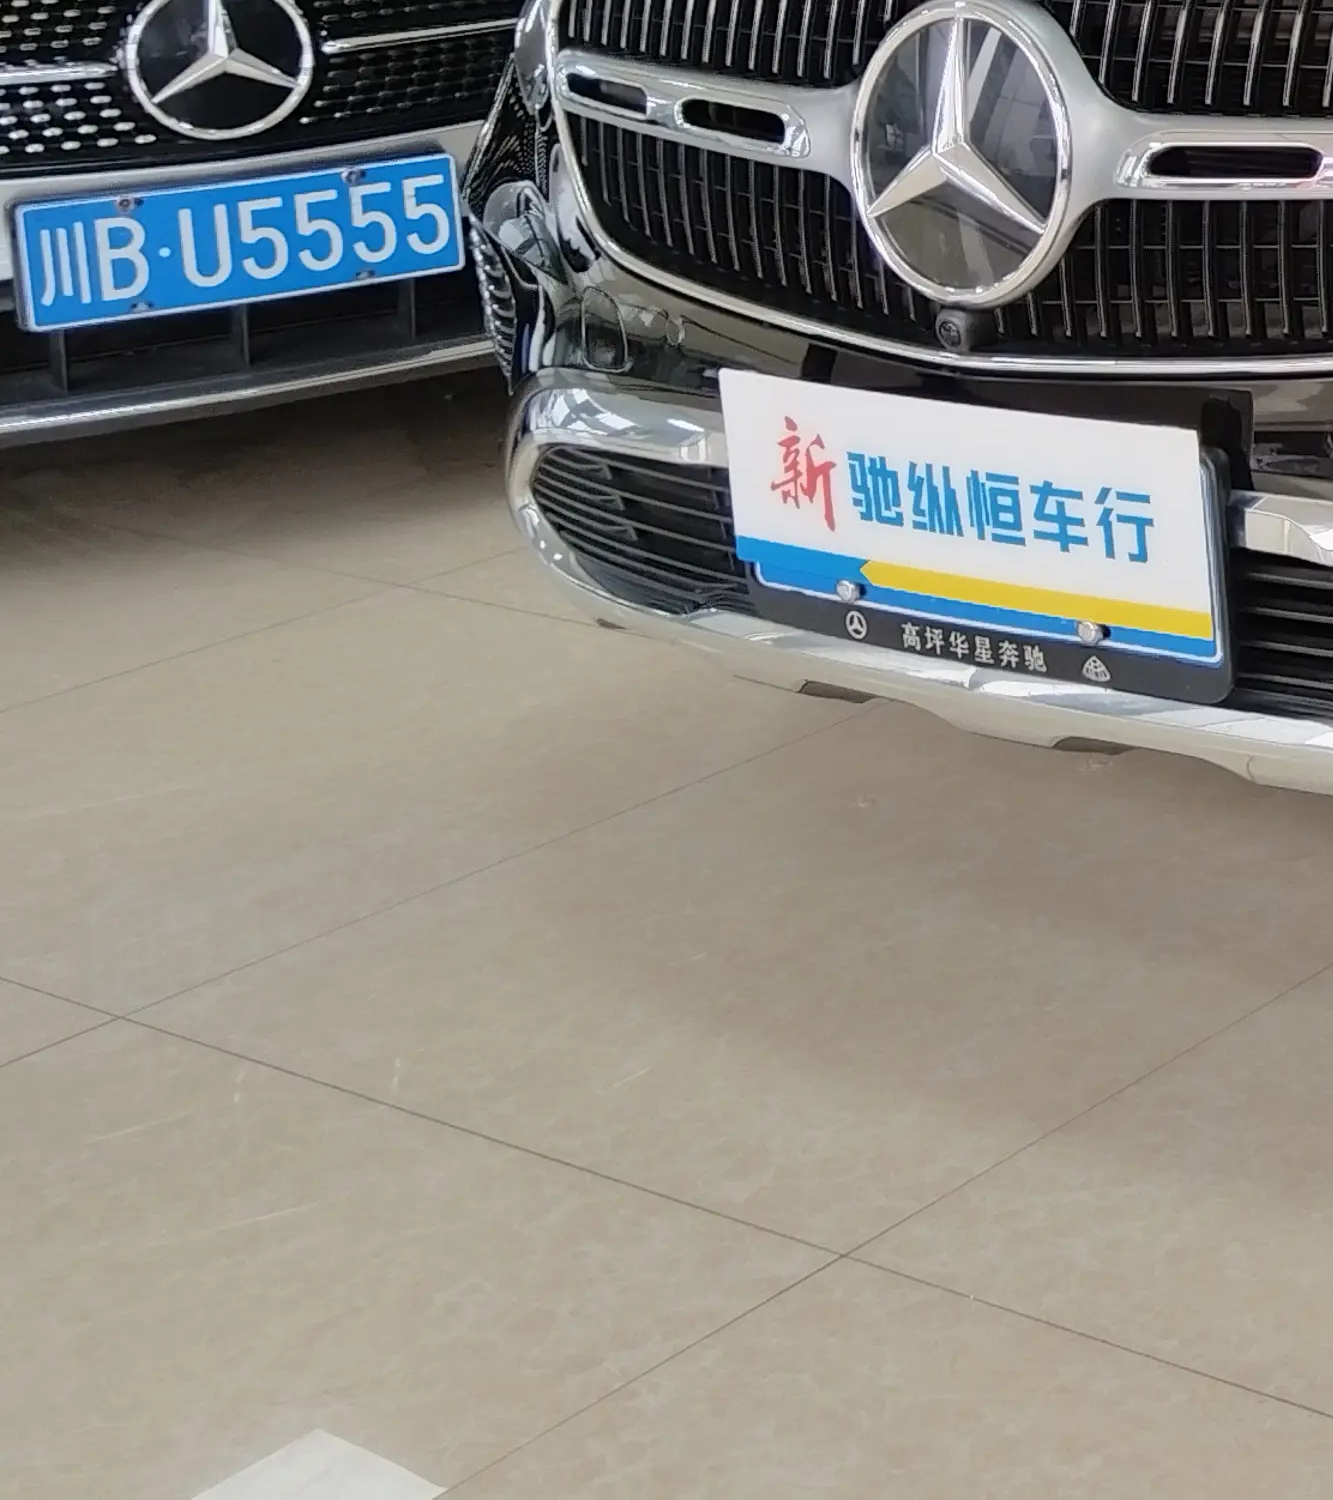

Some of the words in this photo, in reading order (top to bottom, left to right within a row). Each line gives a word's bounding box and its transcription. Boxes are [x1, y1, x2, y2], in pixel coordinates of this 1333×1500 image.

[40, 174, 450, 307] 川B·U5555
[769, 415, 1155, 564] 新驰纵恒车行
[901, 621, 1048, 674] 高坪华星奔驰
